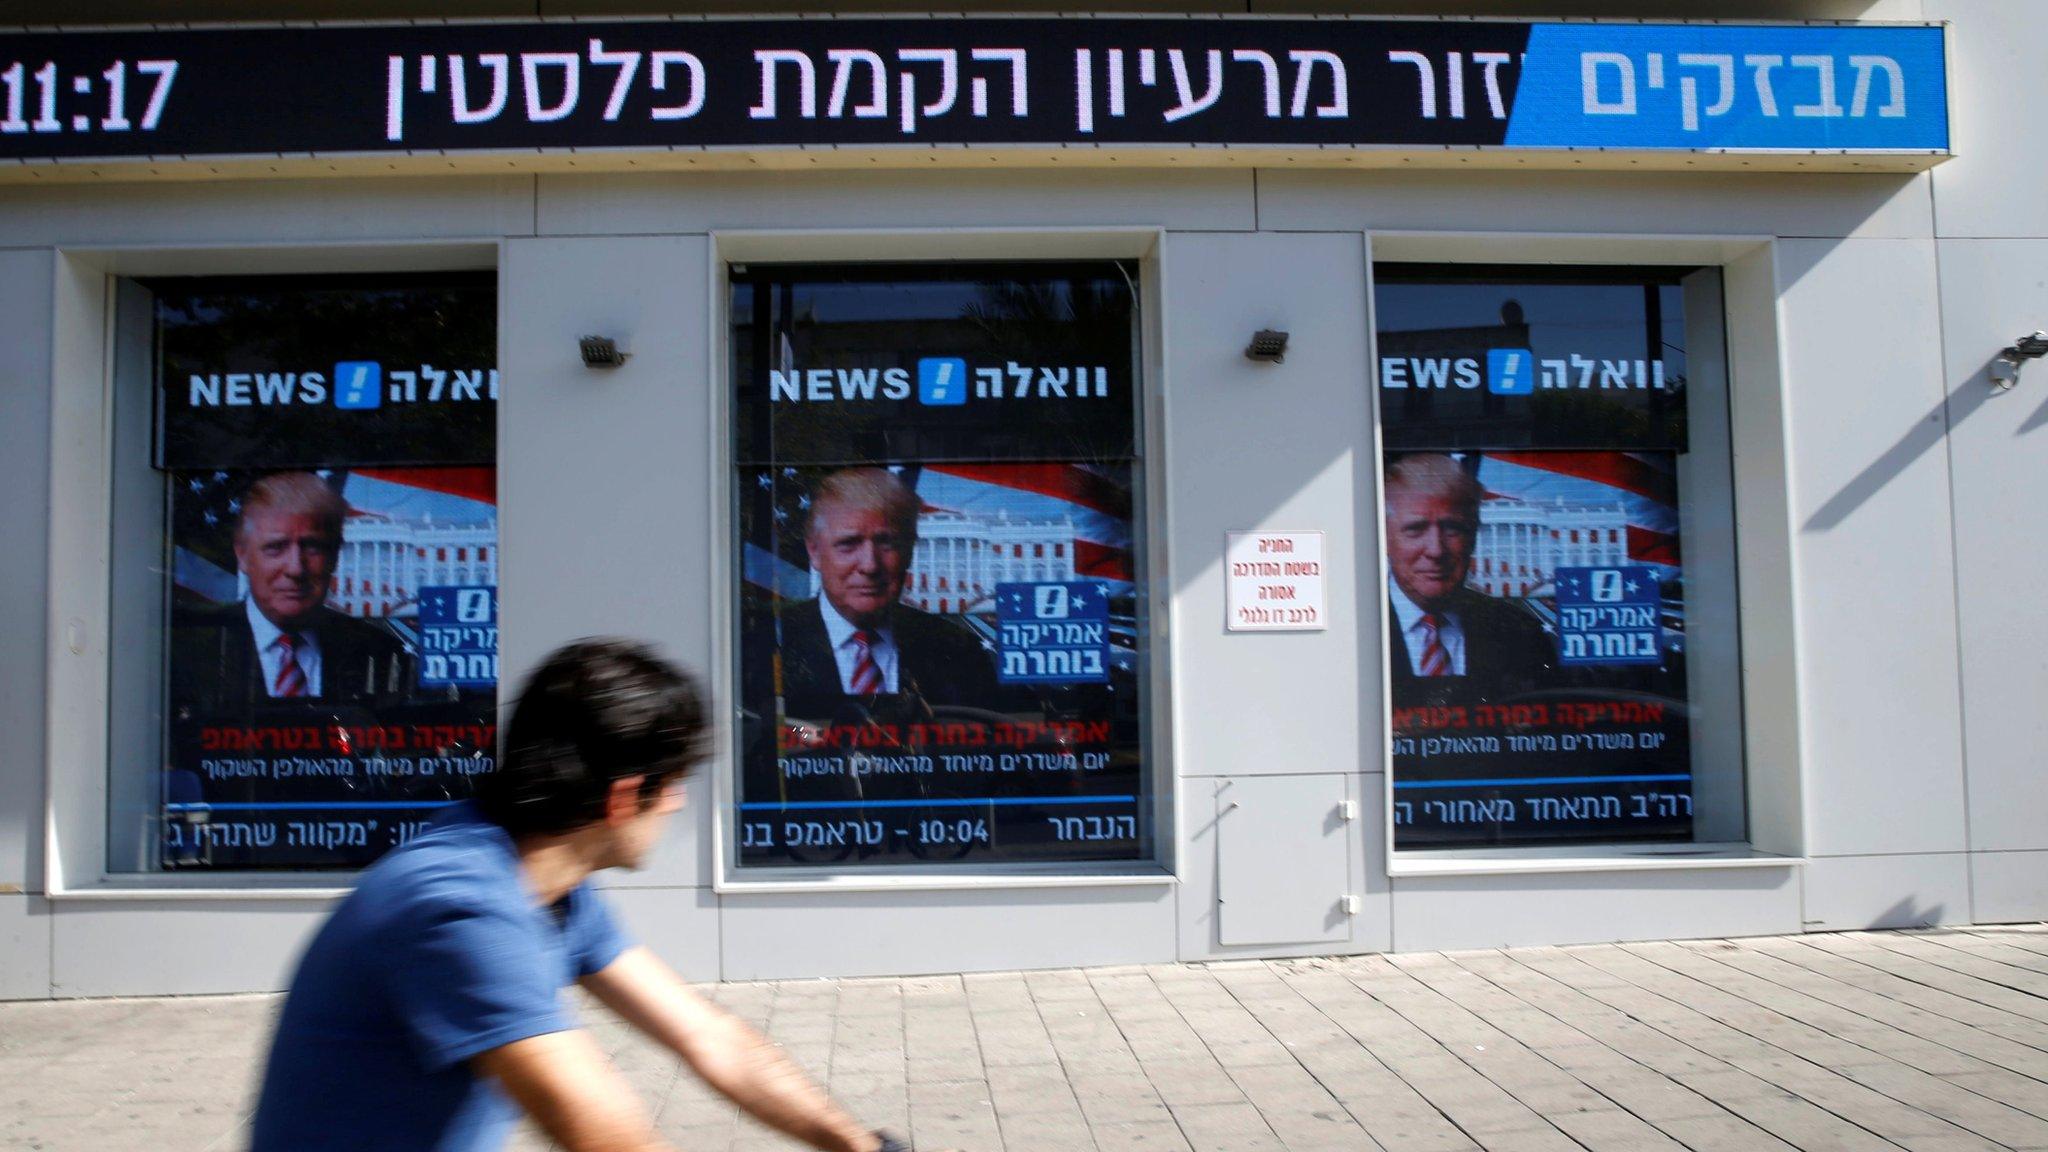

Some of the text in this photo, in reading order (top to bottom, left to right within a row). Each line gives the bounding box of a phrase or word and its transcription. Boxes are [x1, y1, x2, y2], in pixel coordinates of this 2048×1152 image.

[0, 59, 179, 133] 11:17
[387, 38, 1527, 140] זור מרעיון הקמת פלסטין
[1580, 51, 1906, 131] מבזקים
[975, 361, 1108, 399] וואלה
[1541, 353, 1665, 389] וואלה
[190, 372, 327, 406] NEWS
[769, 367, 911, 401] NEWS
[1258, 538, 1293, 553] החניה
[1284, 562, 1319, 576] בשטח
[1258, 585, 1295, 600] אסורה
[1561, 606, 1656, 631] אמריקה
[1002, 623, 1103, 647] אמריקה
[1563, 632, 1657, 657] בוחרת
[1003, 649, 1104, 675] בוחרת
[1474, 703, 1549, 727] בחרה
[1556, 702, 1664, 731] אמריקה
[201, 726, 322, 751] בטראמפ
[908, 722, 987, 746] בחרה
[1421, 735, 1500, 758] מהאולפן
[1504, 735, 1556, 752] מיוחד
[1561, 733, 1635, 751] משדרים
[1639, 732, 1666, 749] יום
[201, 758, 267, 781] השקוף
[272, 756, 354, 780] מהאולפן
[778, 757, 844, 778] השקוף
[938, 755, 994, 773] מיוחד
[1000, 753, 1077, 771] משדרים
[1083, 752, 1110, 770] יום
[1423, 799, 1516, 825] מאחורי
[1524, 795, 1621, 822] תתאחד
[785, 820, 884, 847] טראמפ
[919, 818, 989, 844] 10:04
[1047, 816, 1136, 841] הנבחר
